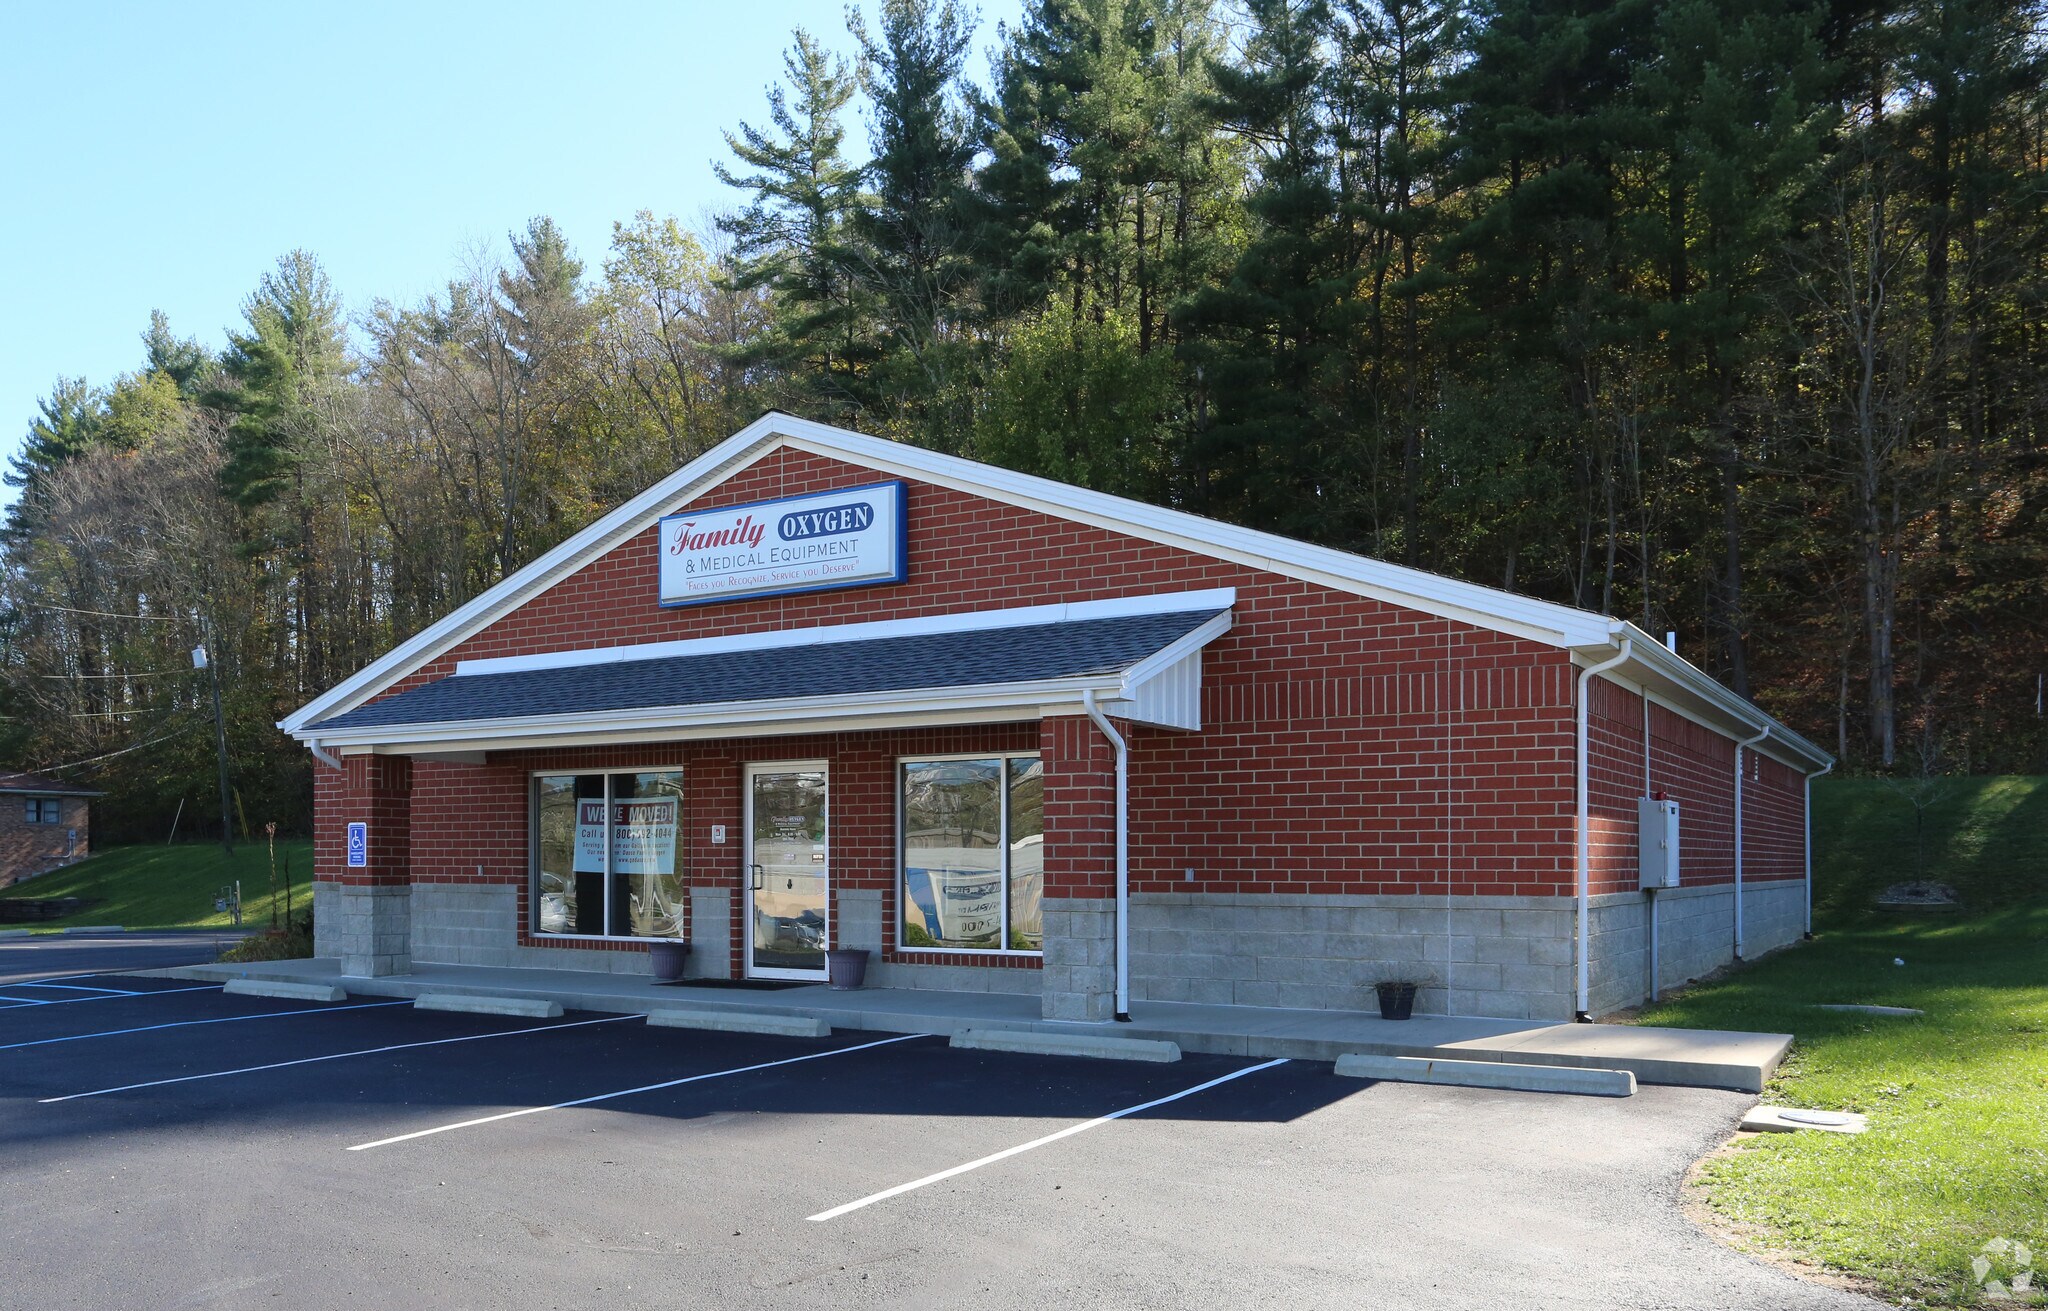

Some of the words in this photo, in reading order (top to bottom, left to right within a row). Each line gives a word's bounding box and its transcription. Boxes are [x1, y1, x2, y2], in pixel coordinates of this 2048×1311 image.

[670, 515, 766, 556] Family
[783, 506, 869, 537] OXYGEN
[685, 559, 695, 574] &
[700, 552, 765, 572] MEDICAL
[770, 539, 859, 562] EQUIPMENT
[628, 805, 673, 822] MOVED!
[581, 829, 597, 838] Call
